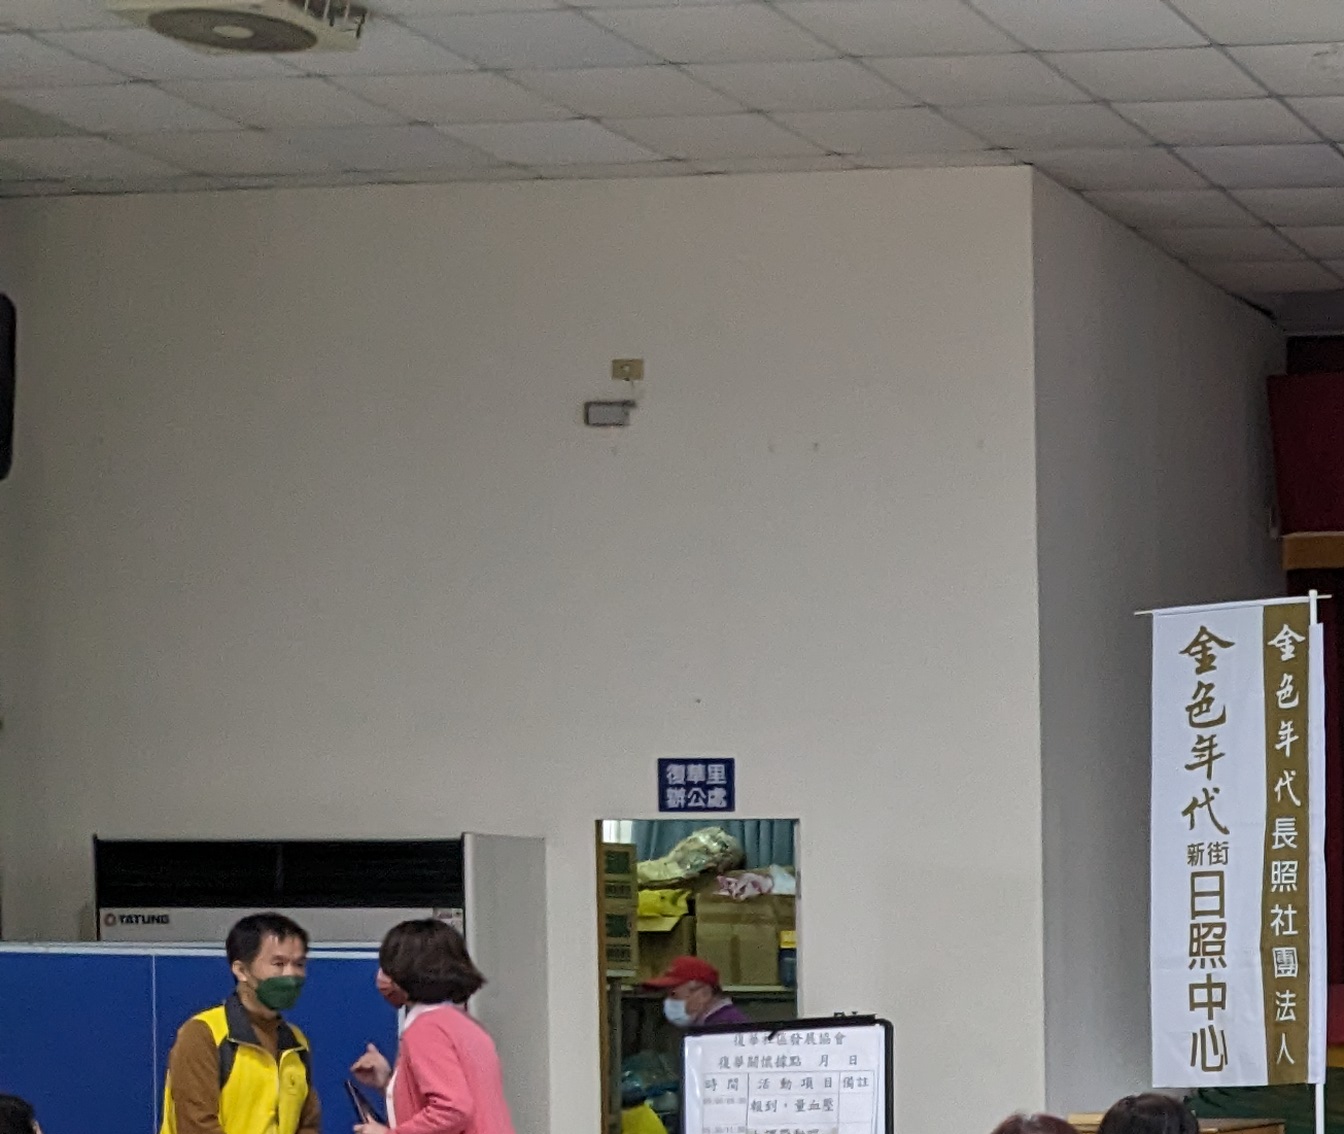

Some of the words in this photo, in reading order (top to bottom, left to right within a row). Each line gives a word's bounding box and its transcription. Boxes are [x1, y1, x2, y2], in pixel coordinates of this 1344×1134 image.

[666, 763, 727, 786] 復華里
[666, 787, 727, 809] 辦公處
[1186, 842, 1229, 866] 新街
[1267, 624, 1305, 1065] 金色年代長照社團法人
[119, 914, 170, 924] TATUNG
[1188, 870, 1228, 1072] 日照中心
[818, 1055, 829, 1067] 月
[849, 1055, 858, 1066] 日
